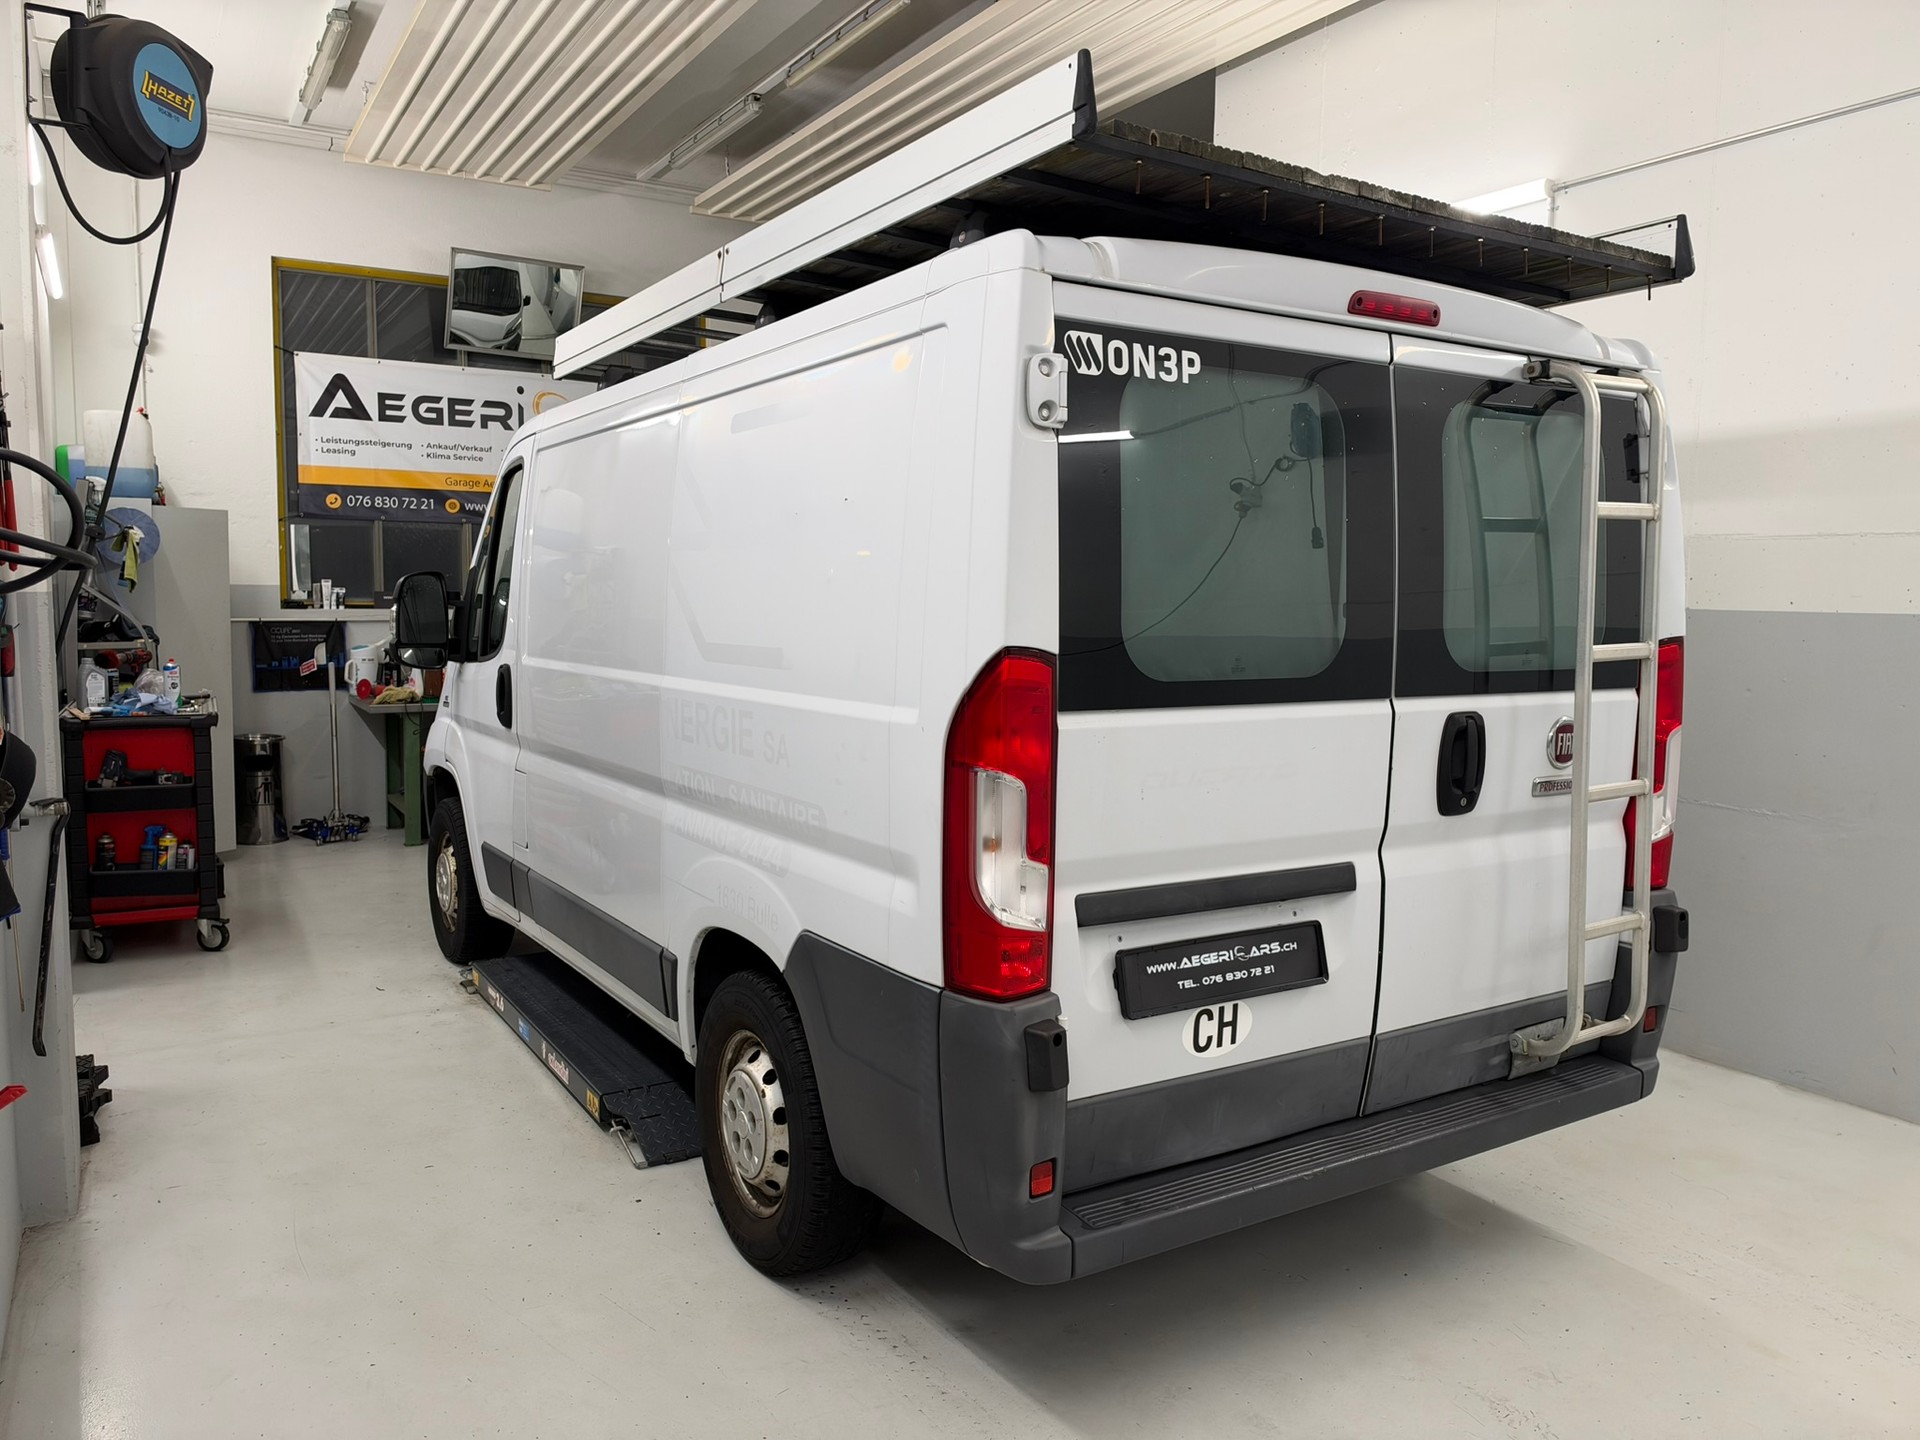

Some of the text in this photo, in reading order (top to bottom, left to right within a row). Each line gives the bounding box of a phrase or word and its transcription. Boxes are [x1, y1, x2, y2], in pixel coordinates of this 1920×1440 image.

[147, 79, 190, 108] HAZET
[1107, 339, 1201, 384] ON3P
[320, 436, 413, 450] Leistungssteigerung
[426, 442, 493, 453] Ankauf/Verkauf
[321, 447, 356, 456] Leasing
[426, 452, 484, 462] Klima Service
[445, 477, 481, 489] Garage
[346, 494, 434, 510] 076 830 72 21
[1556, 733, 1574, 755] FIA
[1177, 965, 1275, 990] TEL. 076 830 72 21
[1193, 1002, 1239, 1054] CH
